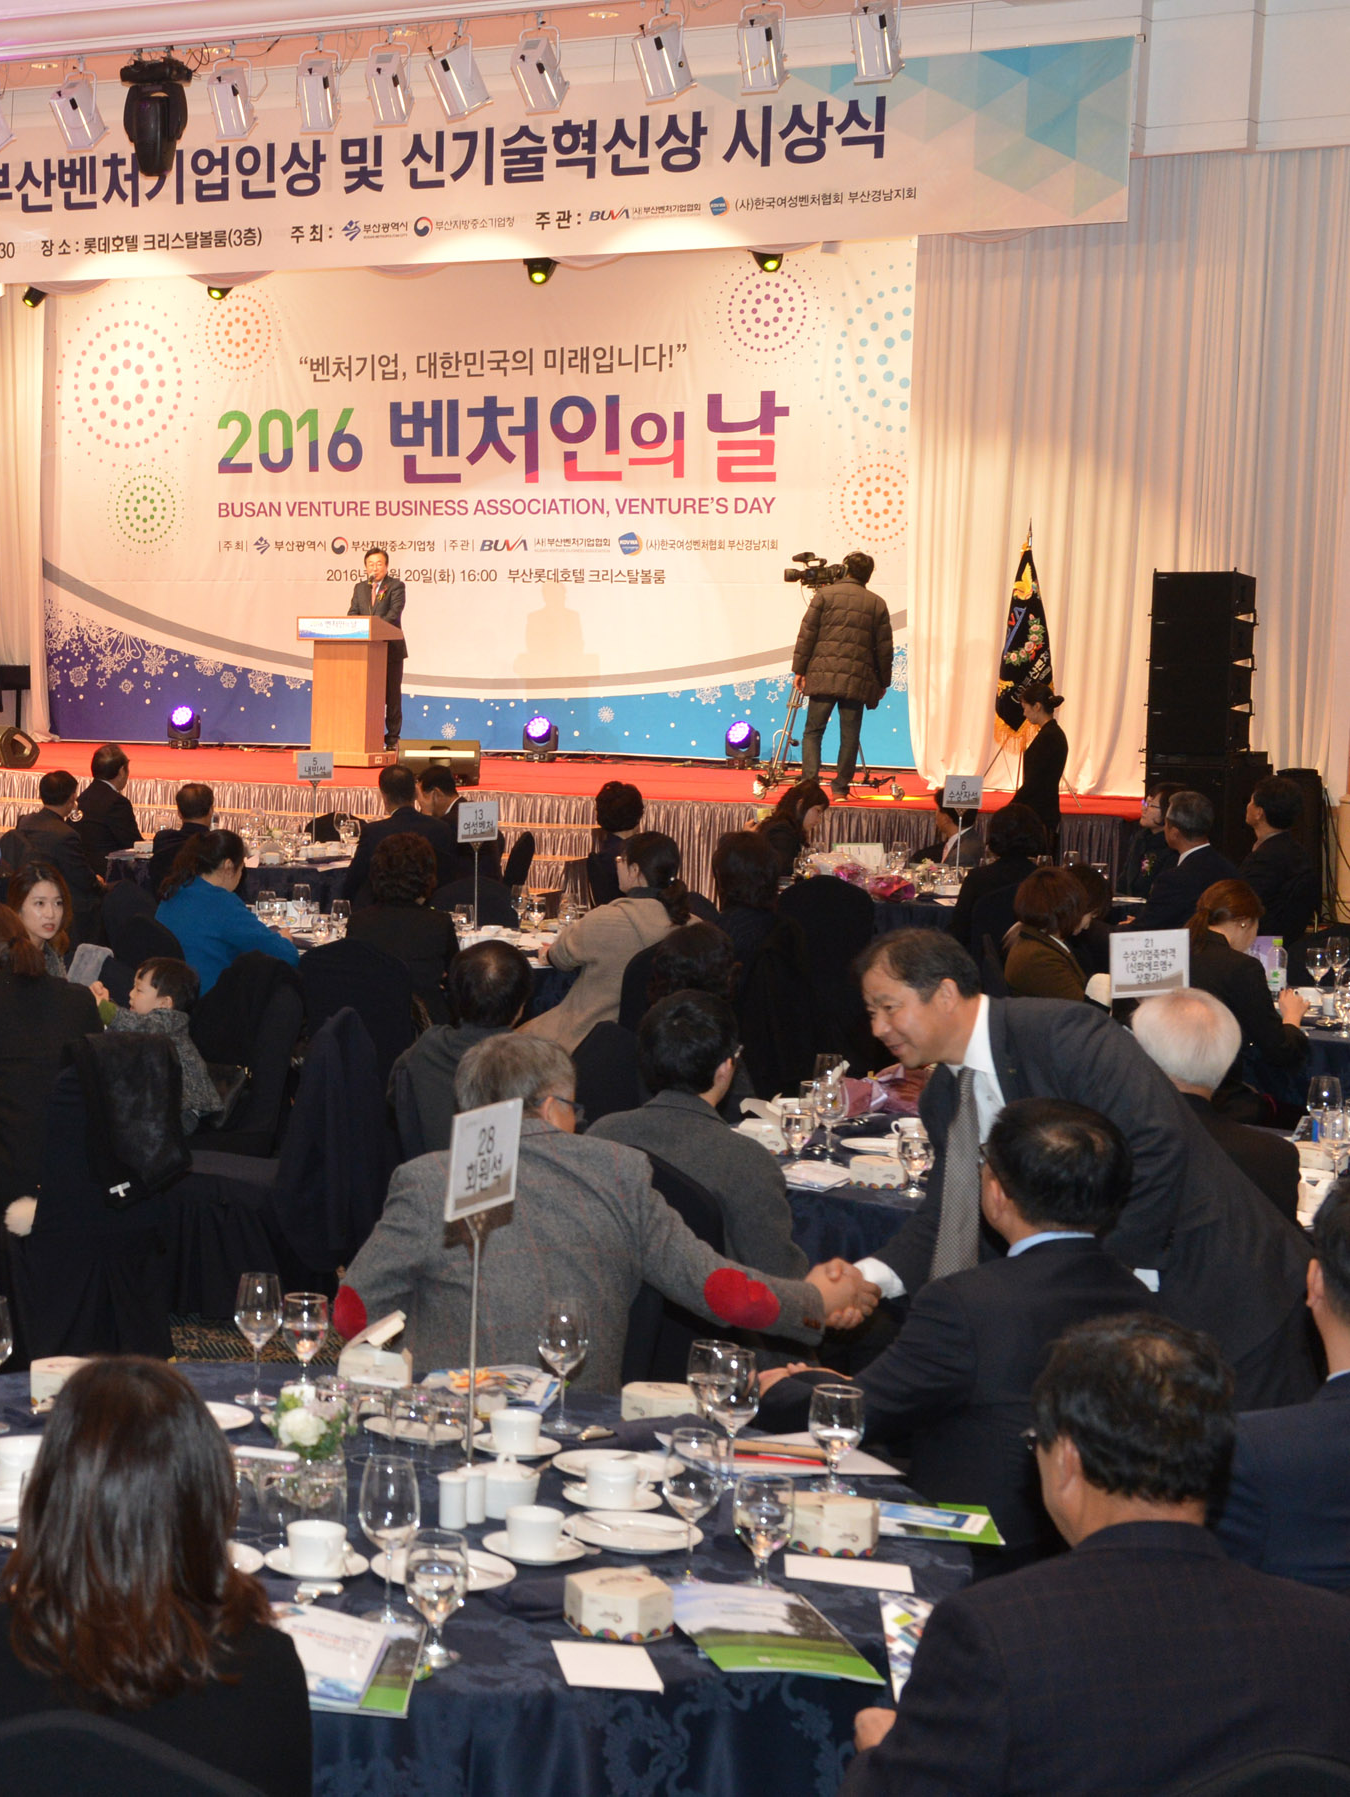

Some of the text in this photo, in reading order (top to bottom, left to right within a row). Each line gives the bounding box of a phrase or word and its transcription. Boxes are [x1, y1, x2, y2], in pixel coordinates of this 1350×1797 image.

[340, 134, 385, 195] 및
[402, 109, 707, 190] 신기술혁신상
[723, 95, 888, 170] 시상식
[535, 210, 552, 231] 주
[554, 209, 573, 230] 관
[734, 191, 844, 213] (사)한국여성벤처협회
[847, 186, 919, 206] 부산경남지회
[41, 238, 55, 257] 장
[83, 233, 139, 255] 롯데호텔
[143, 227, 263, 252] 크리스탈볼룸(3층)
[290, 226, 306, 244] 주
[308, 224, 325, 243] 최
[362, 220, 409, 234] 부산광역시
[434, 216, 516, 232] 부산지방중소기업청
[415, 348, 534, 380] 대한민국의
[217, 390, 790, 485] 2016 벤처인의 날
[217, 501, 282, 519] BUSAN
[285, 500, 371, 518] VENTURE
[375, 499, 470, 517] BUSINESS
[473, 497, 611, 518] ASSOCIATION,
[733, 496, 777, 515] DAY
[274, 539, 328, 552] 부산광역시
[351, 539, 436, 552] 부산지방중소기업청
[479, 534, 530, 552] BUVA
[645, 538, 726, 552] (사)한국여성벤처협회
[727, 538, 779, 551] 부산경남지회
[404, 568, 457, 585] 20일(화)
[460, 568, 498, 583] 16:00
[507, 567, 586, 584] 부산롯데호텔
[588, 567, 667, 584] 크리스탈볼룸
[313, 757, 318, 766] 5
[961, 781, 967, 790] 6
[474, 809, 484, 821] 13
[463, 821, 495, 835] 여성벤처
[1144, 938, 1154, 948] 21
[477, 1125, 497, 1157] 28
[464, 1152, 503, 1193] 회원석
